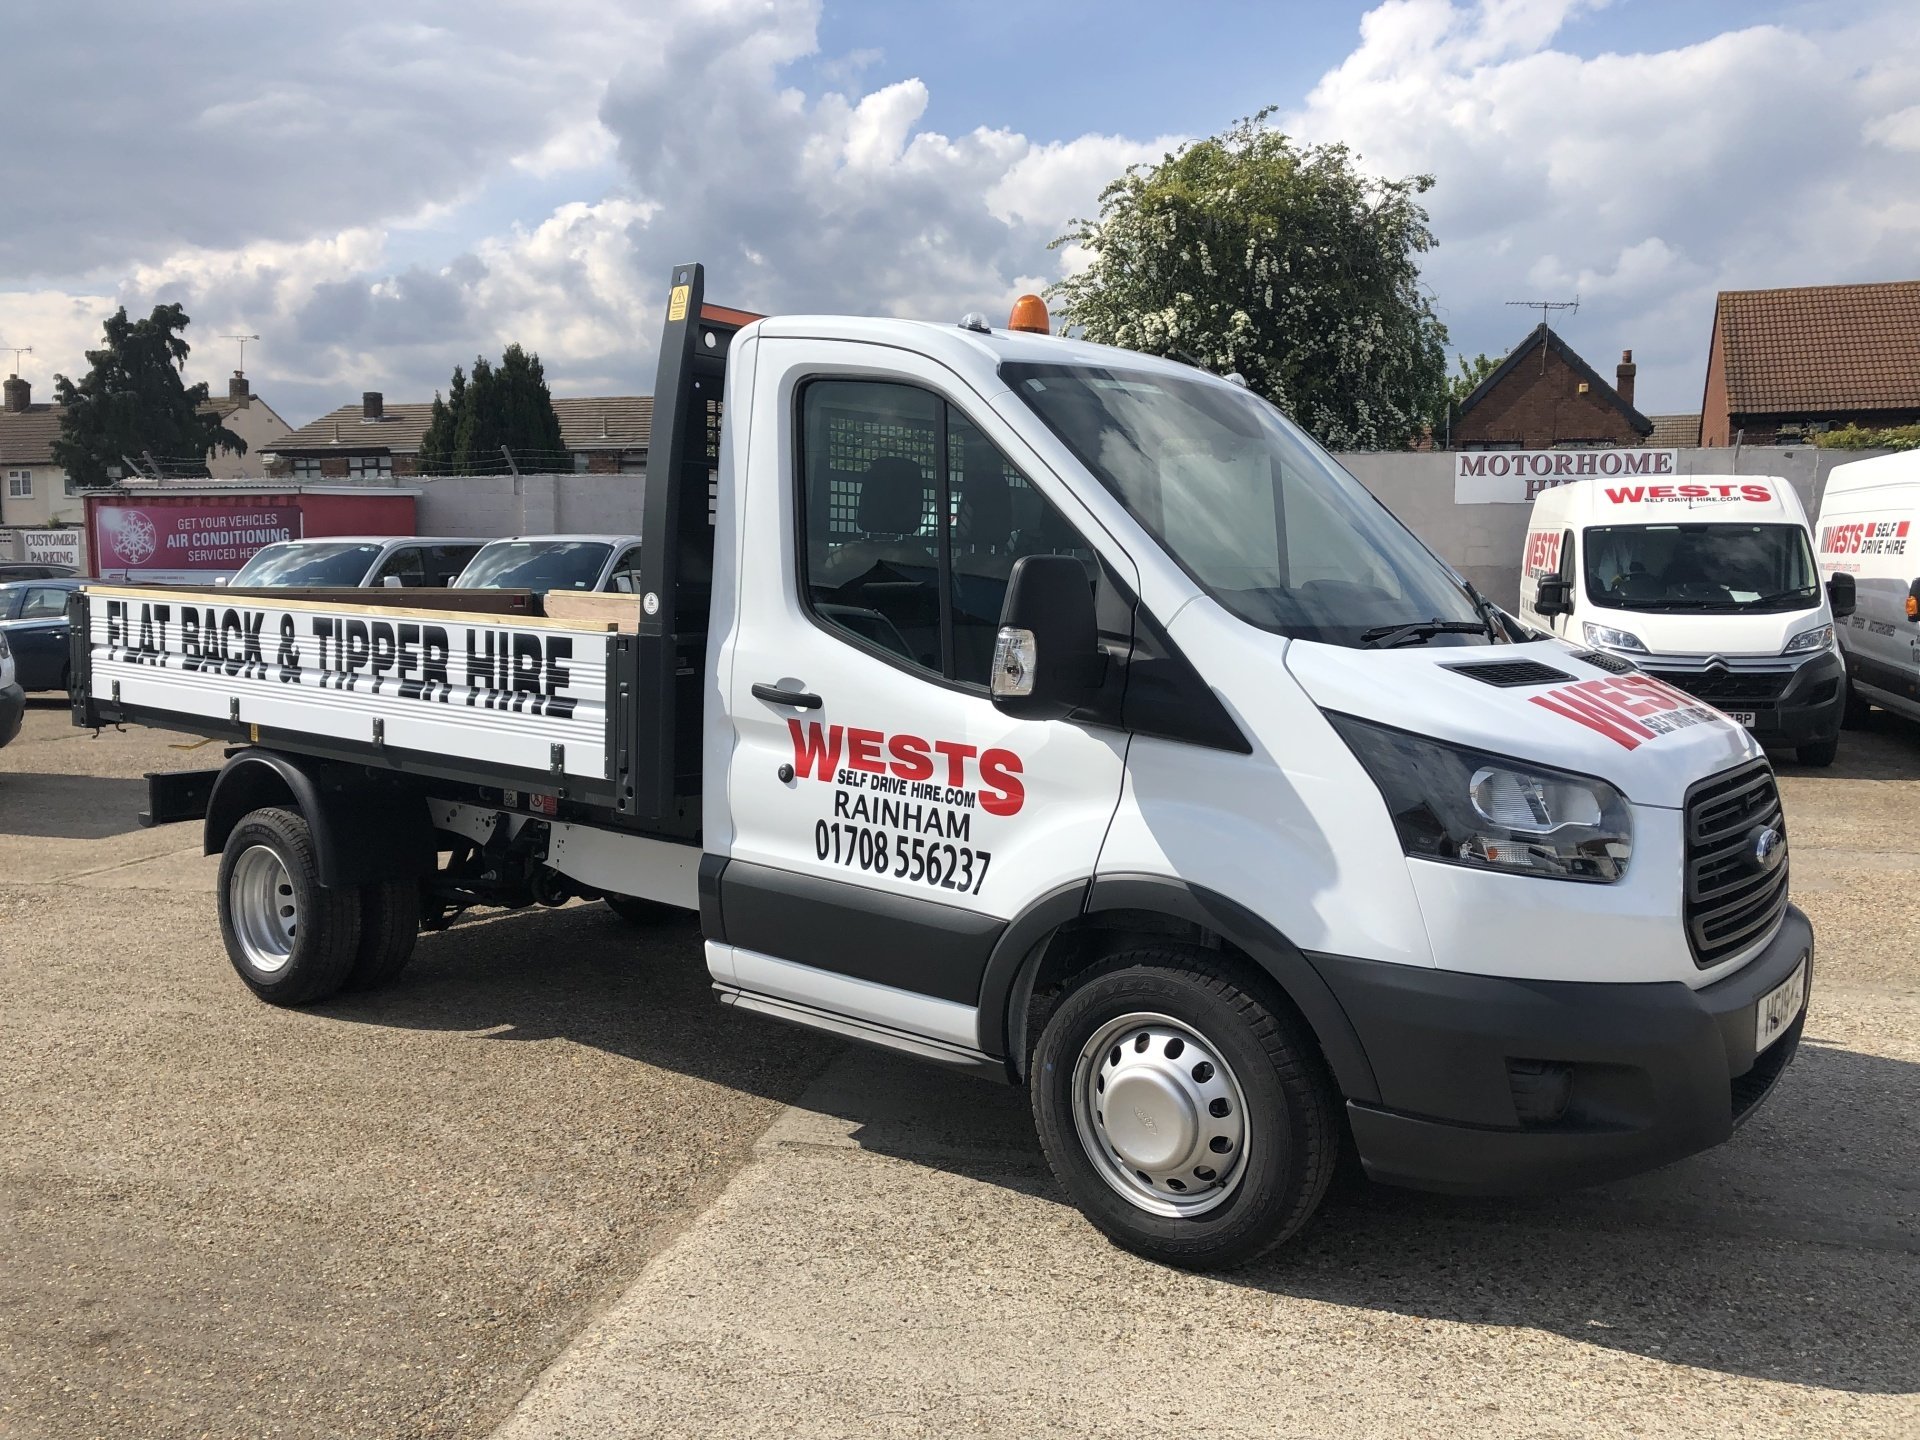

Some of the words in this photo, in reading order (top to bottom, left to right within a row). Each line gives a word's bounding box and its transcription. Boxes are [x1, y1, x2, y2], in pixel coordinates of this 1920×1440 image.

[1460, 452, 1673, 476] MOTORHOME
[1604, 485, 1772, 504] WESTS
[177, 518, 196, 530] GET
[200, 516, 226, 529] YOUR
[229, 513, 277, 527] VEHICLES
[1876, 522, 1897, 537] SELF
[25, 533, 78, 547] CUSTOMER
[167, 533, 189, 548] AIR
[192, 528, 290, 547] CONDITIONING
[1825, 523, 1864, 554] WESTS
[1861, 539, 1884, 554] DRIVE
[1884, 539, 1907, 555] HIRE
[30, 551, 74, 564] PARKING
[188, 548, 237, 562] SERVICED
[240, 546, 262, 559] HER
[1525, 532, 1560, 576] WESTS
[107, 600, 171, 668] FLAT
[181, 606, 266, 680] BACK
[277, 613, 301, 684] &
[312, 616, 453, 704] TIPPER
[466, 628, 578, 720] HIRE
[1527, 676, 1697, 751] WEST
[787, 718, 1025, 817] WESTS
[837, 768, 870, 788] SELF
[870, 774, 908, 796] DRIVE
[910, 781, 976, 809] HIRE.COM
[834, 789, 971, 842] RAINHAM
[815, 818, 889, 874] 01708
[894, 835, 992, 896] 556237
